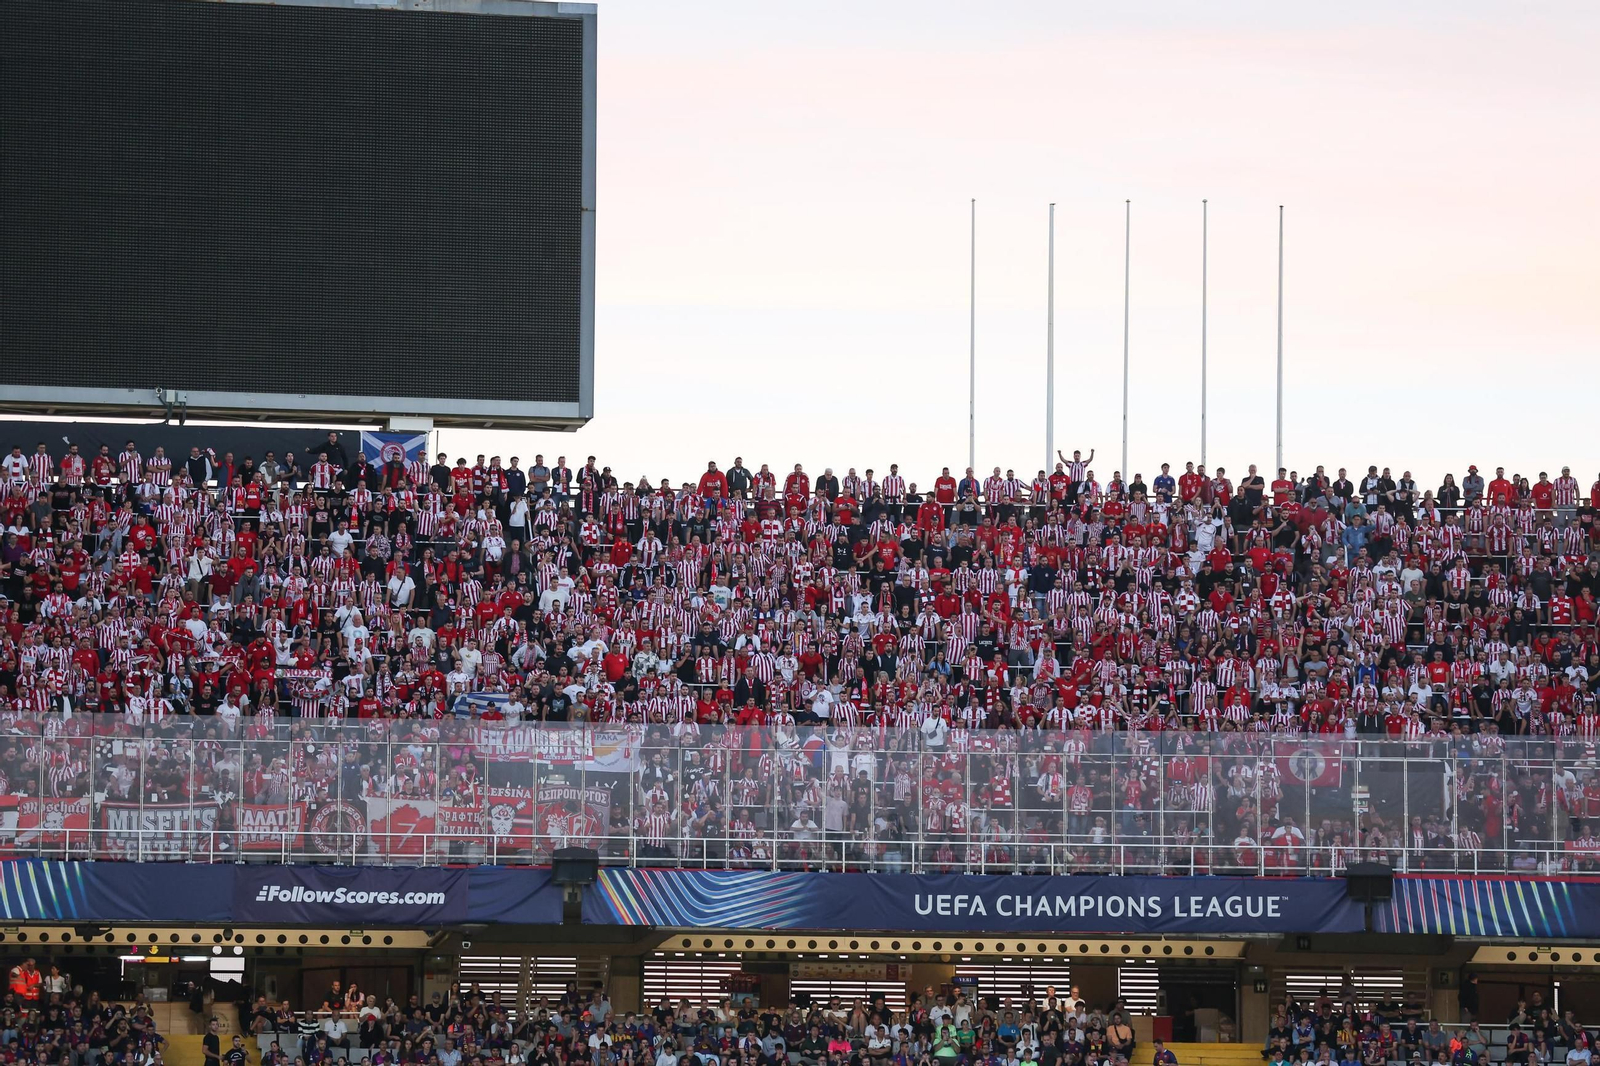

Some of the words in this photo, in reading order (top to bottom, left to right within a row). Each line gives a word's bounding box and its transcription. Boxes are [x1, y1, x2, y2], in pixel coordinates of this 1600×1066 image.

[106, 808, 217, 839] MISFITS
[396, 822, 417, 849] 7
[267, 886, 445, 905] FollowScores.com
[914, 894, 987, 916] UEFA
[995, 895, 1162, 918] CHAMPIONS
